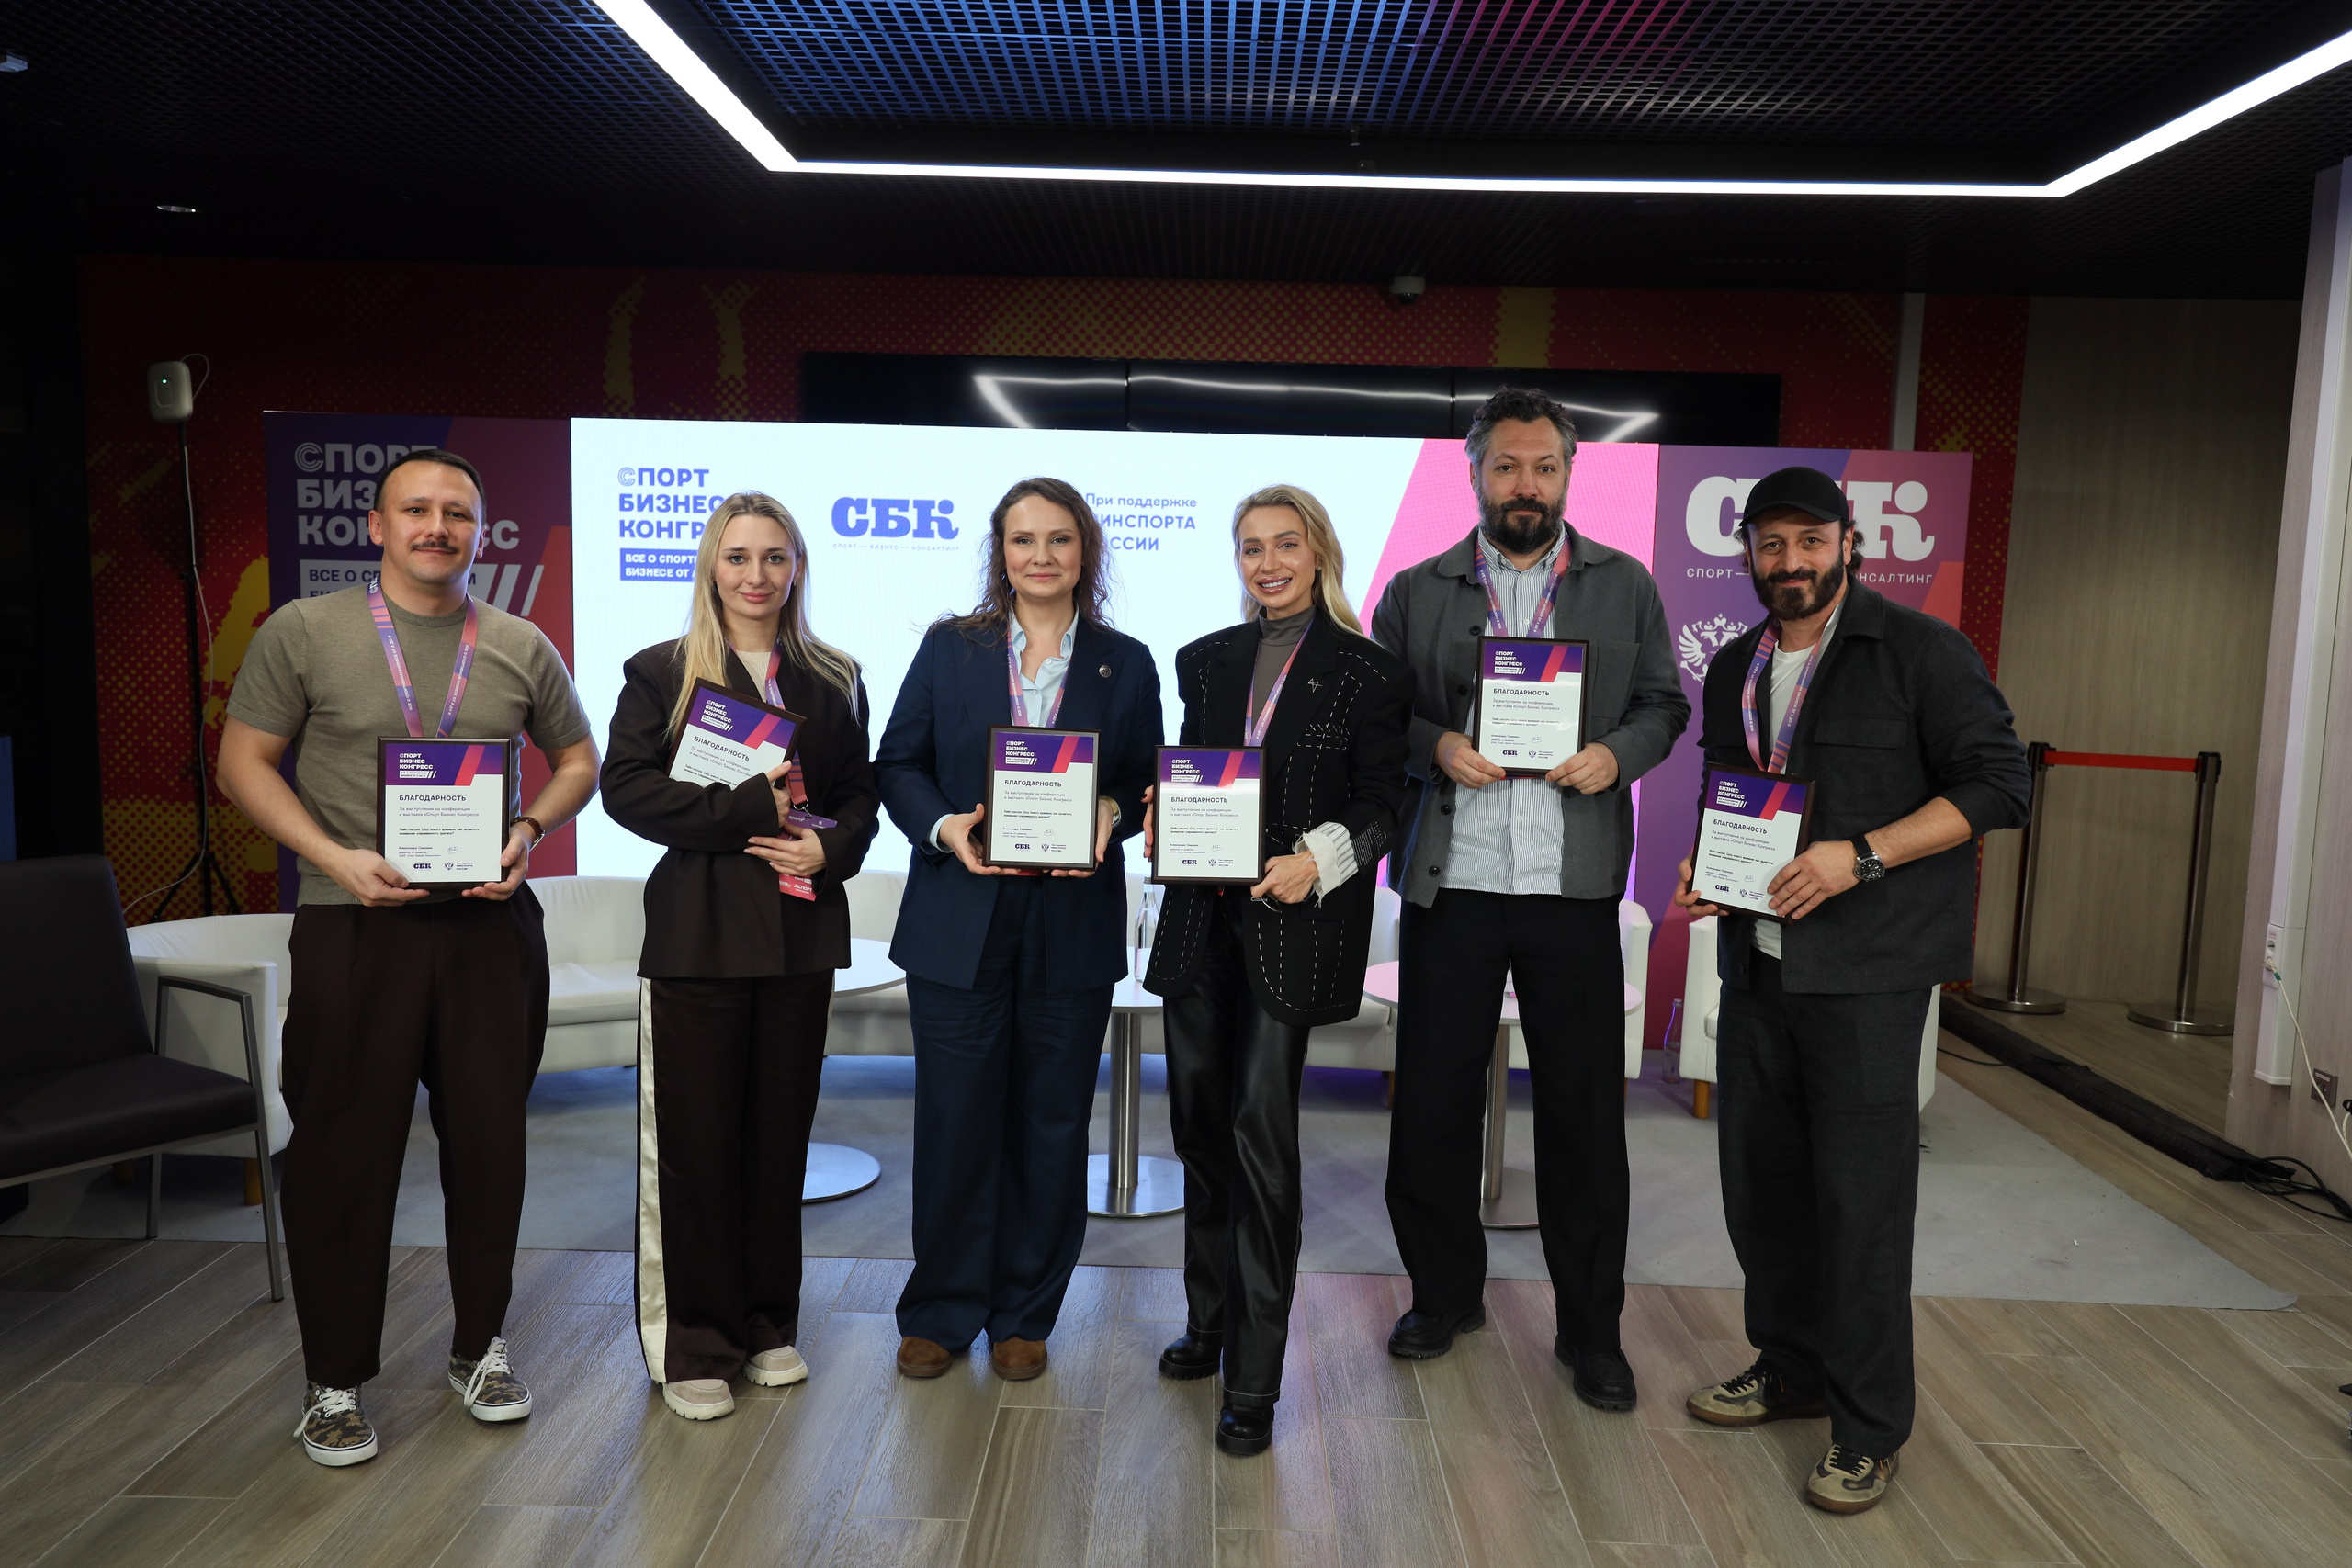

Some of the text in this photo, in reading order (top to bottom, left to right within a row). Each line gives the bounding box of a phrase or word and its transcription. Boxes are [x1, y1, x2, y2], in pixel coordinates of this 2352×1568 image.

[617, 467, 709, 488] СПОРТ
[1085, 492, 1197, 510] При поддержке
[831, 496, 959, 540] СБК
[1098, 513, 1196, 530] ИНСПОРТА
[1685, 475, 1936, 562] СК
[619, 519, 706, 540] КОНГР
[1109, 536, 1159, 551] ССИИ
[625, 554, 646, 563] ВСЕ
[647, 554, 657, 563] О
[309, 570, 340, 581] ВСЕ
[345, 570, 356, 582] О
[625, 567, 674, 578] БИЗНЕСЕ
[675, 569, 690, 578] ОТ
[1687, 568, 1734, 579] СПОРТ
[1855, 572, 1933, 584] НСАЛТИНГ
[1493, 688, 1549, 697] БЛАГОДАРНОСТЬ
[705, 704, 727, 716] БИЗНЕС
[707, 699, 725, 711] СПОРТ
[703, 708, 731, 724] КОНГРЕСС
[694, 736, 749, 761] БЛАГОДАРНОСТЬ
[1718, 785, 1739, 794] БИЗНЕС
[1719, 780, 1737, 788] СПОРТ
[1717, 790, 1746, 800] КОНГРЕСС
[1713, 819, 1768, 835] БЛАГОДАРНОСТЬ
